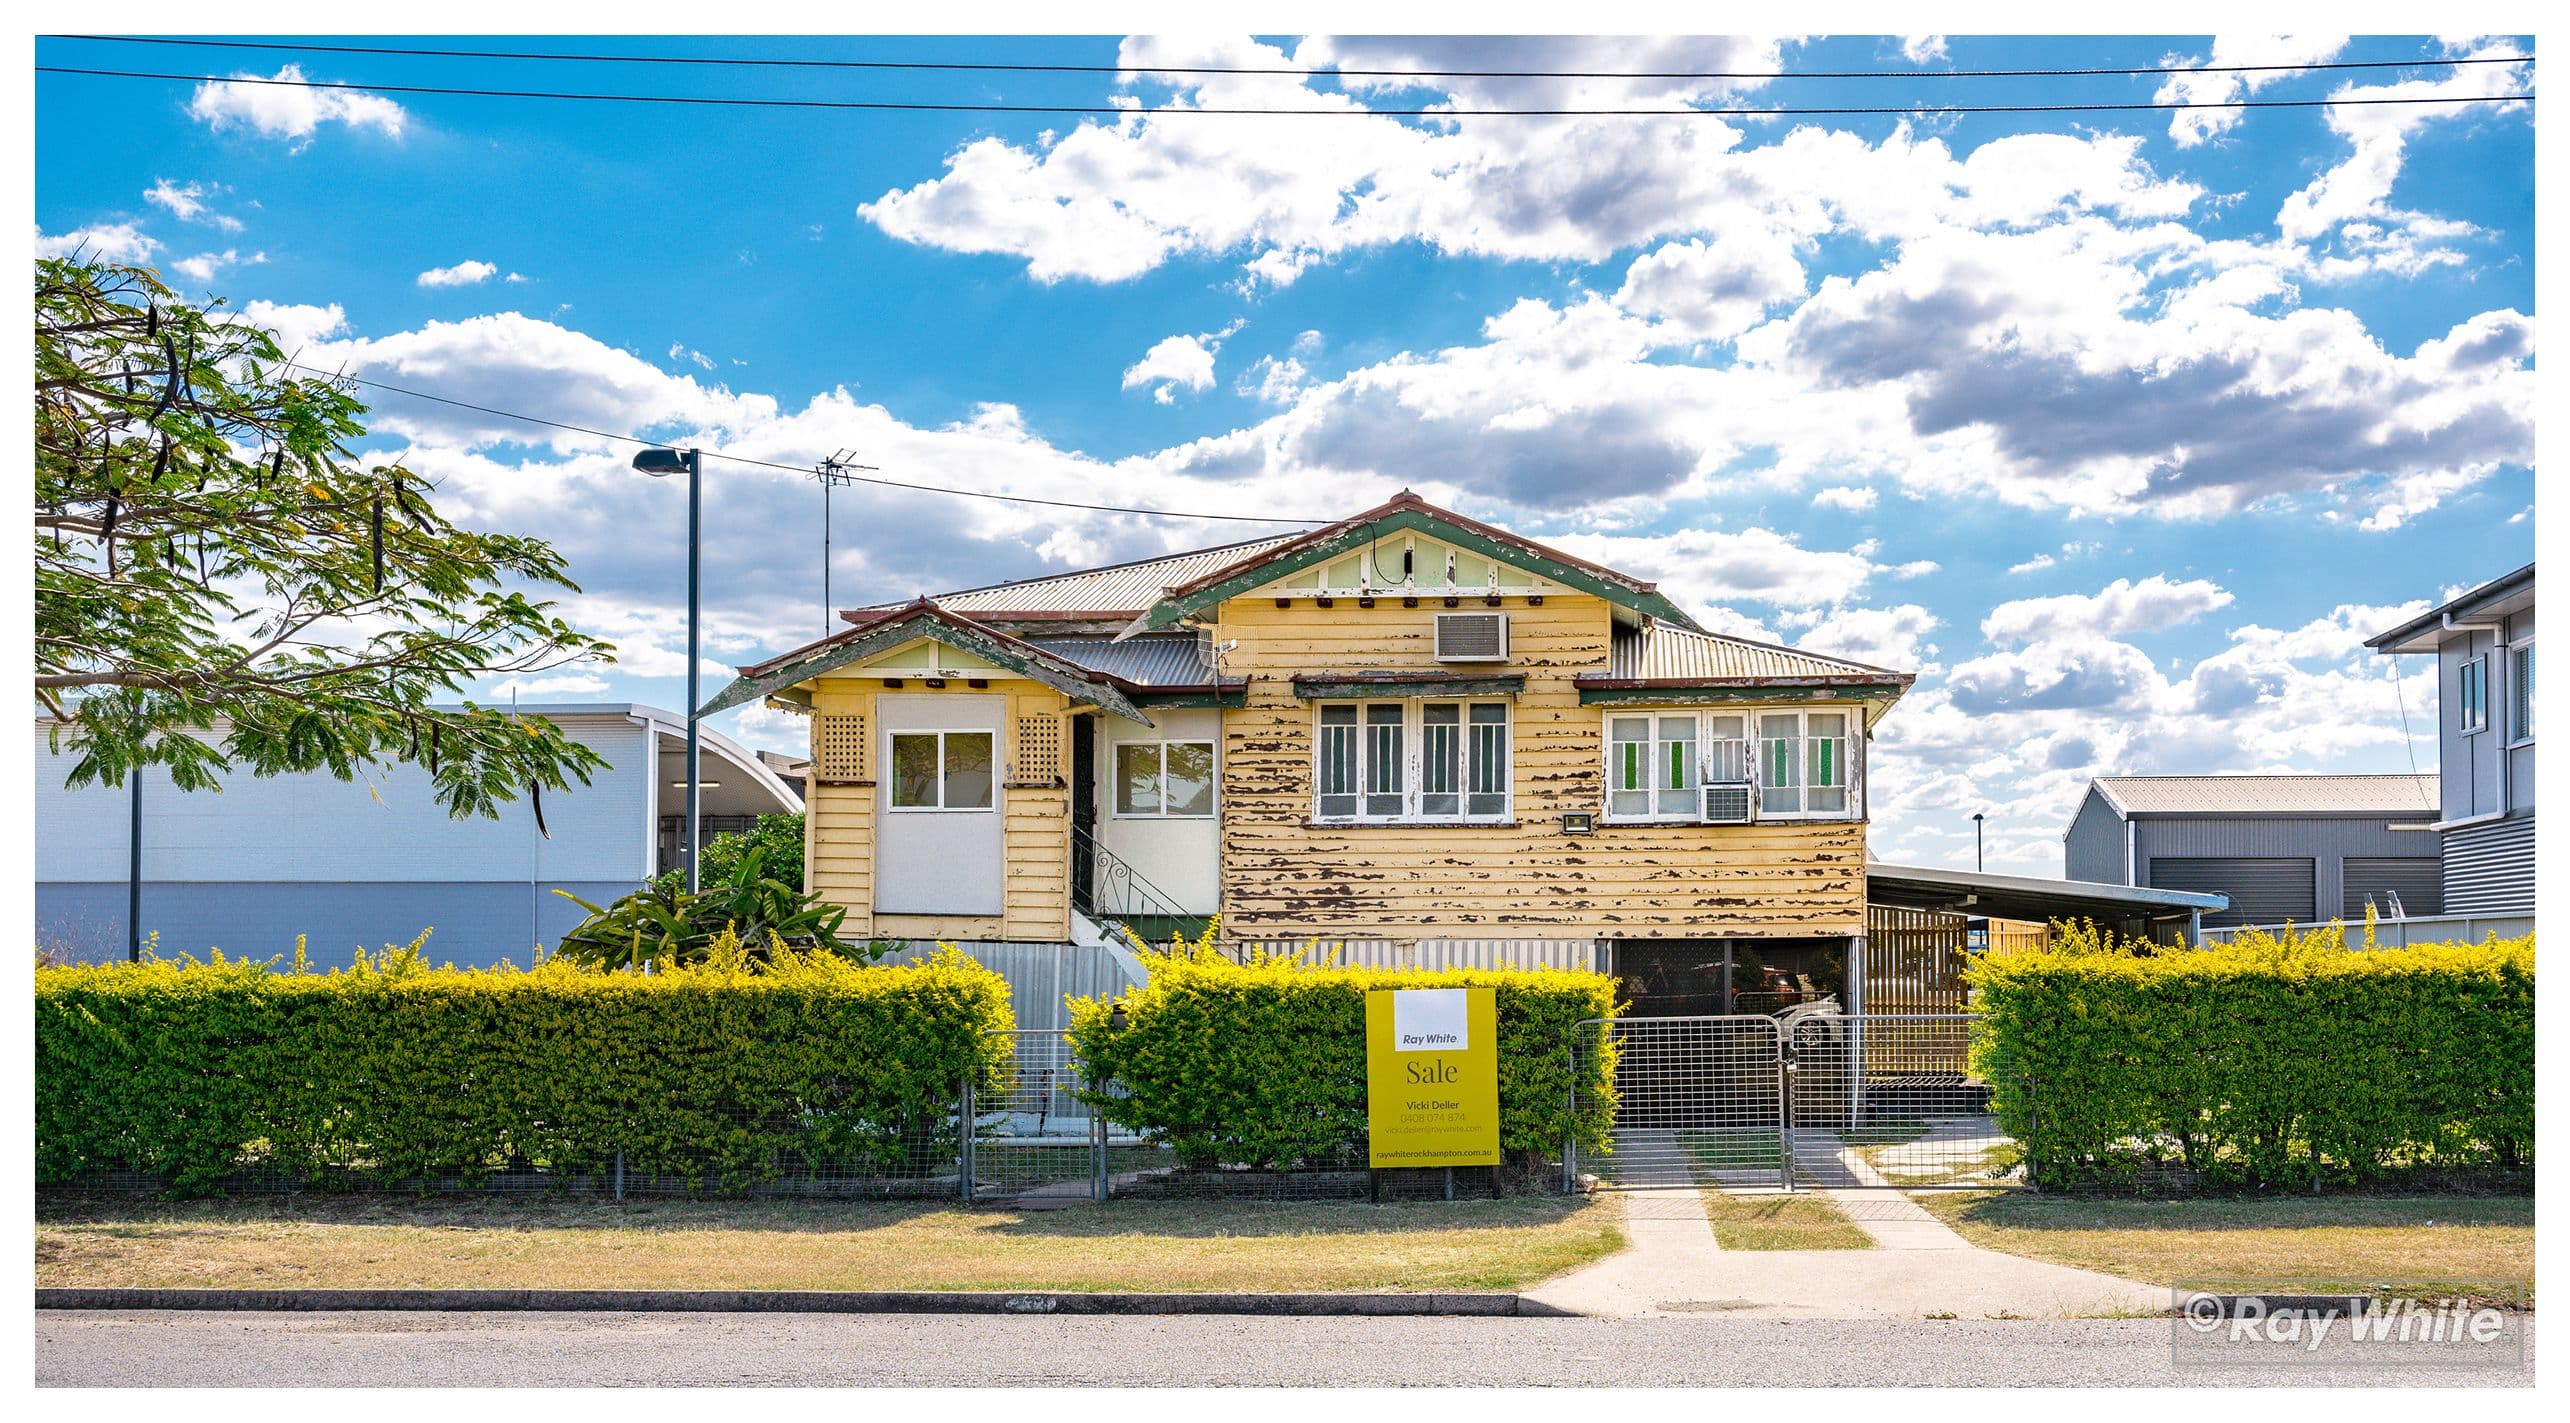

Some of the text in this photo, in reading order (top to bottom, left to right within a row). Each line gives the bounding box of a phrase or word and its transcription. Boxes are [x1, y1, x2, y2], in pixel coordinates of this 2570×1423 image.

[1403, 1033, 1457, 1046] Ray White
[1407, 1059, 1458, 1084] Sale
[1406, 1100, 1460, 1111] Vicki Deller
[1400, 1113, 1424, 1123] 0408
[1376, 1149, 1492, 1160] raywhiterockhampton.com.au
